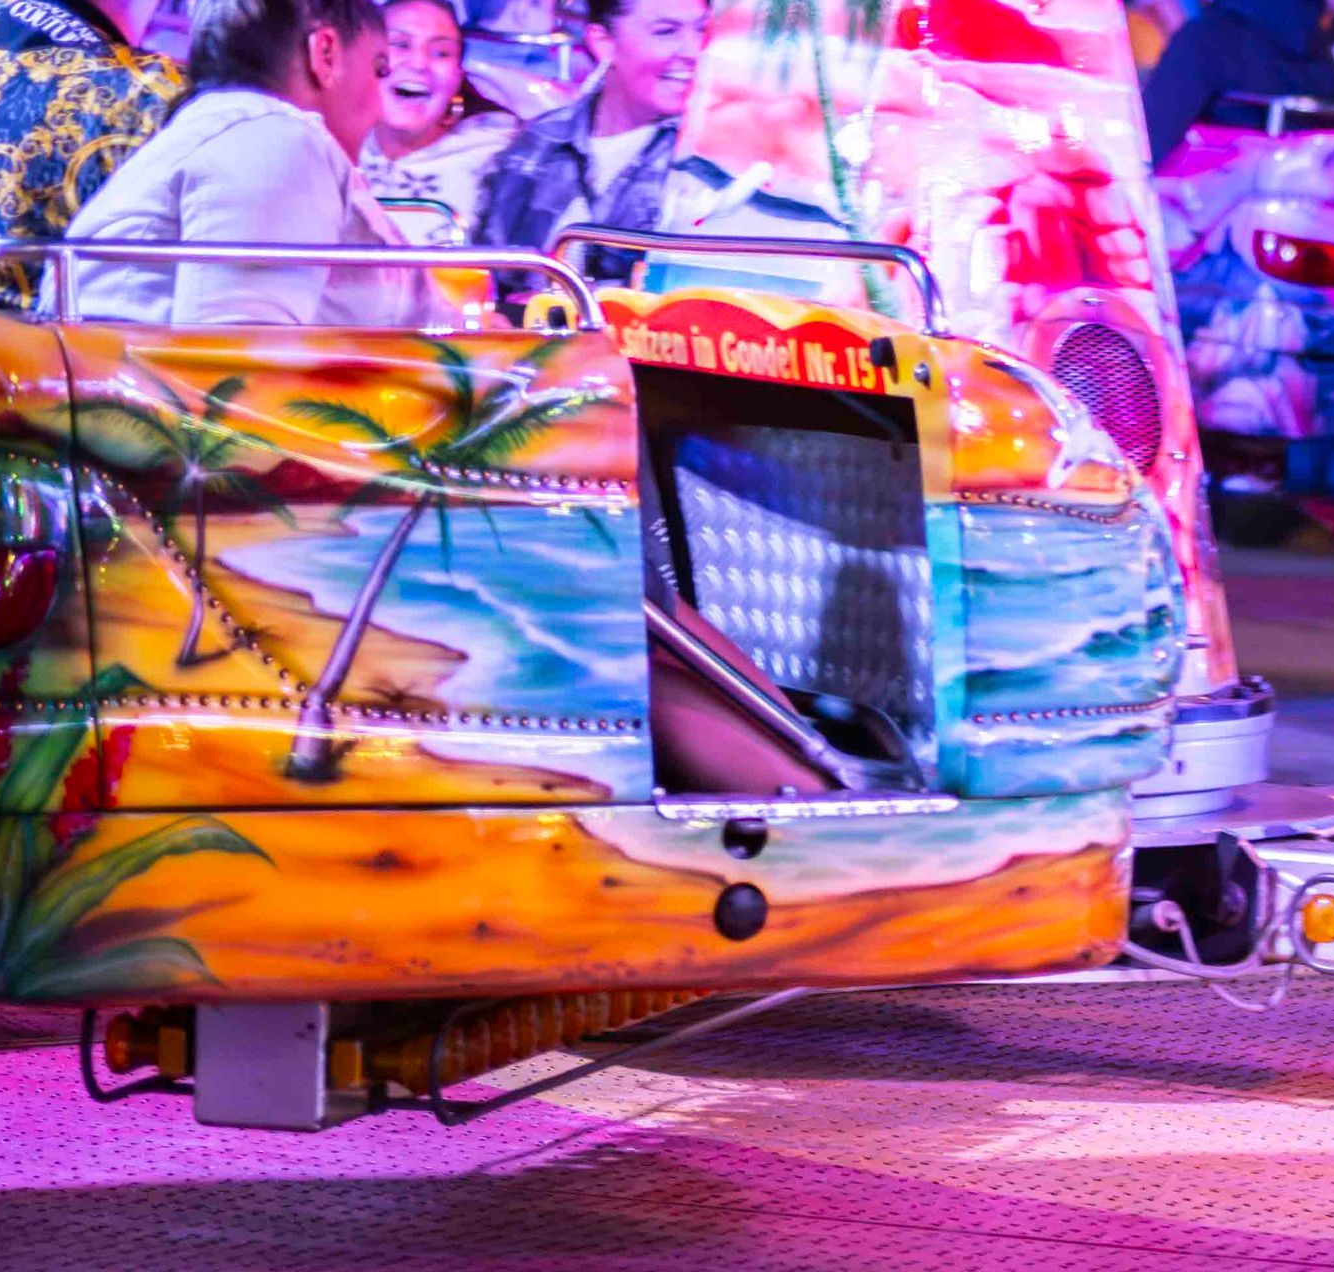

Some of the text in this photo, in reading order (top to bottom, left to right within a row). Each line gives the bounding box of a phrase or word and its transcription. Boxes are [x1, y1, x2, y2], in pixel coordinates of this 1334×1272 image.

[620, 320, 689, 365] sitzen
[690, 325, 718, 369] in
[720, 330, 801, 381] Gondel
[802, 341, 846, 386] Nr.
[845, 346, 877, 390] 15
